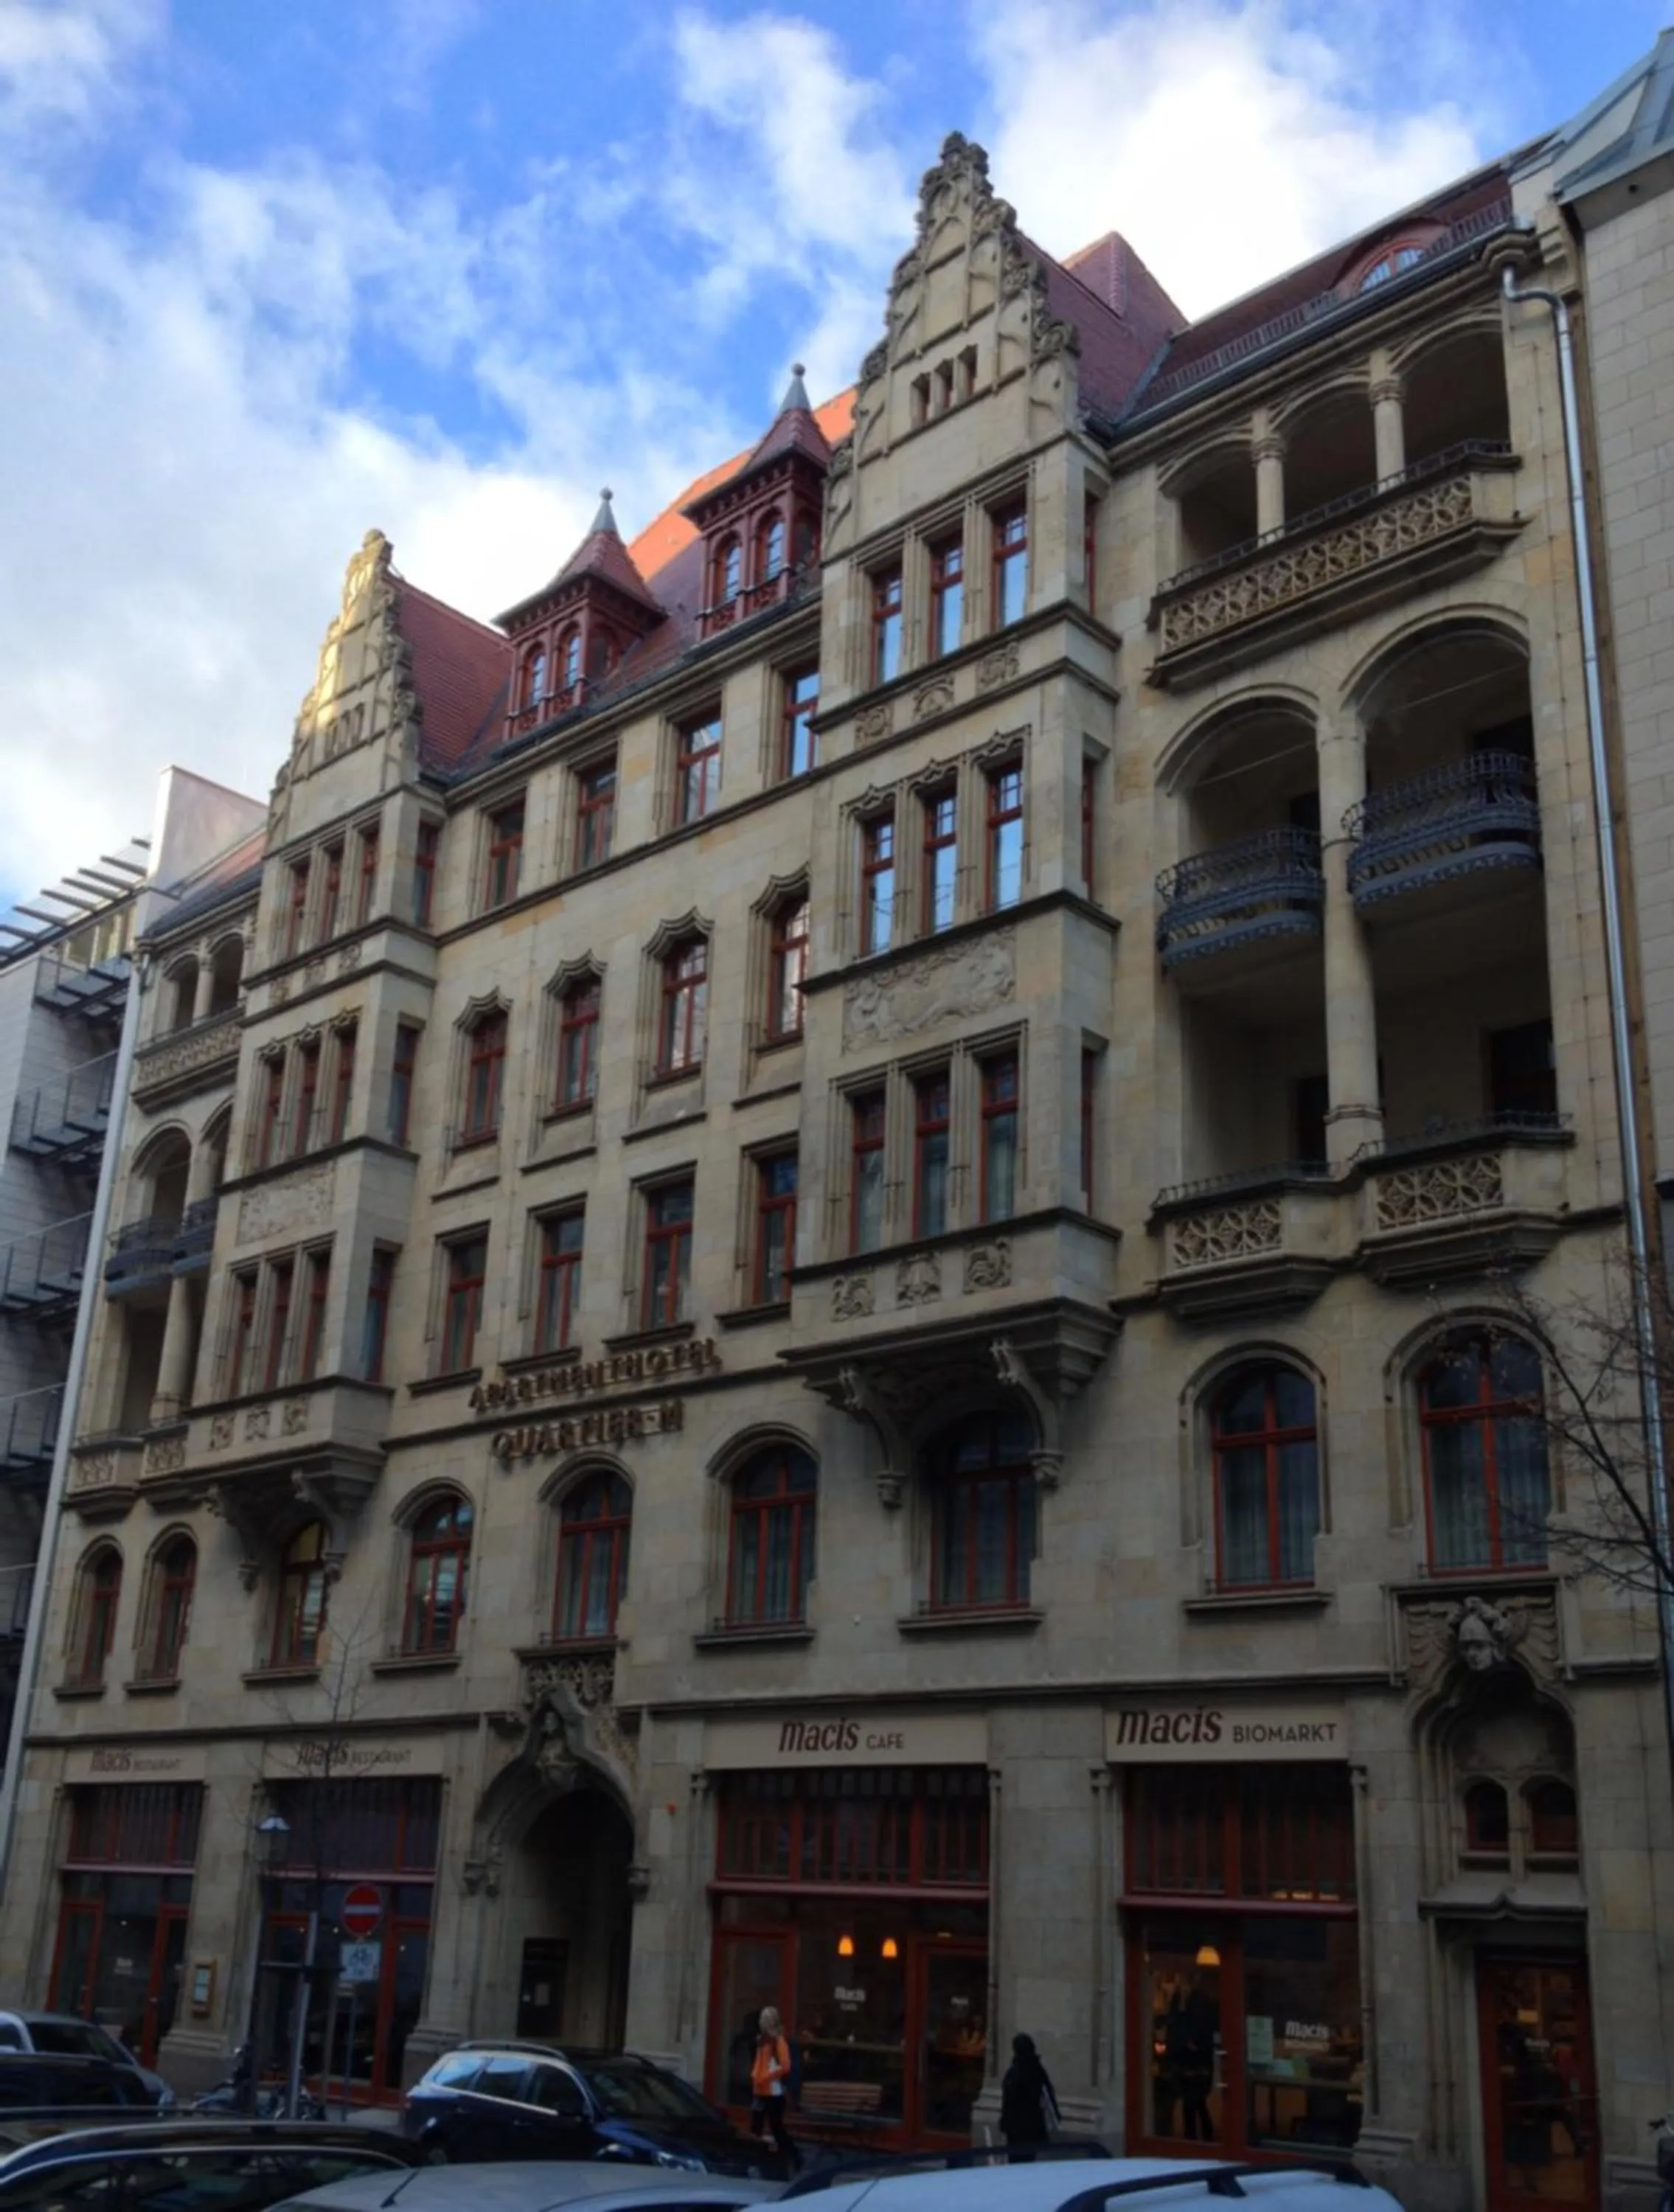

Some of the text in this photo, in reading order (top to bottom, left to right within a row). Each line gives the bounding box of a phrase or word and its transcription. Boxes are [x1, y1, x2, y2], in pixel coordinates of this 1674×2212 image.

[779, 1716, 861, 1752] macis
[1116, 1705, 1337, 1745] macis BIOMARKT
